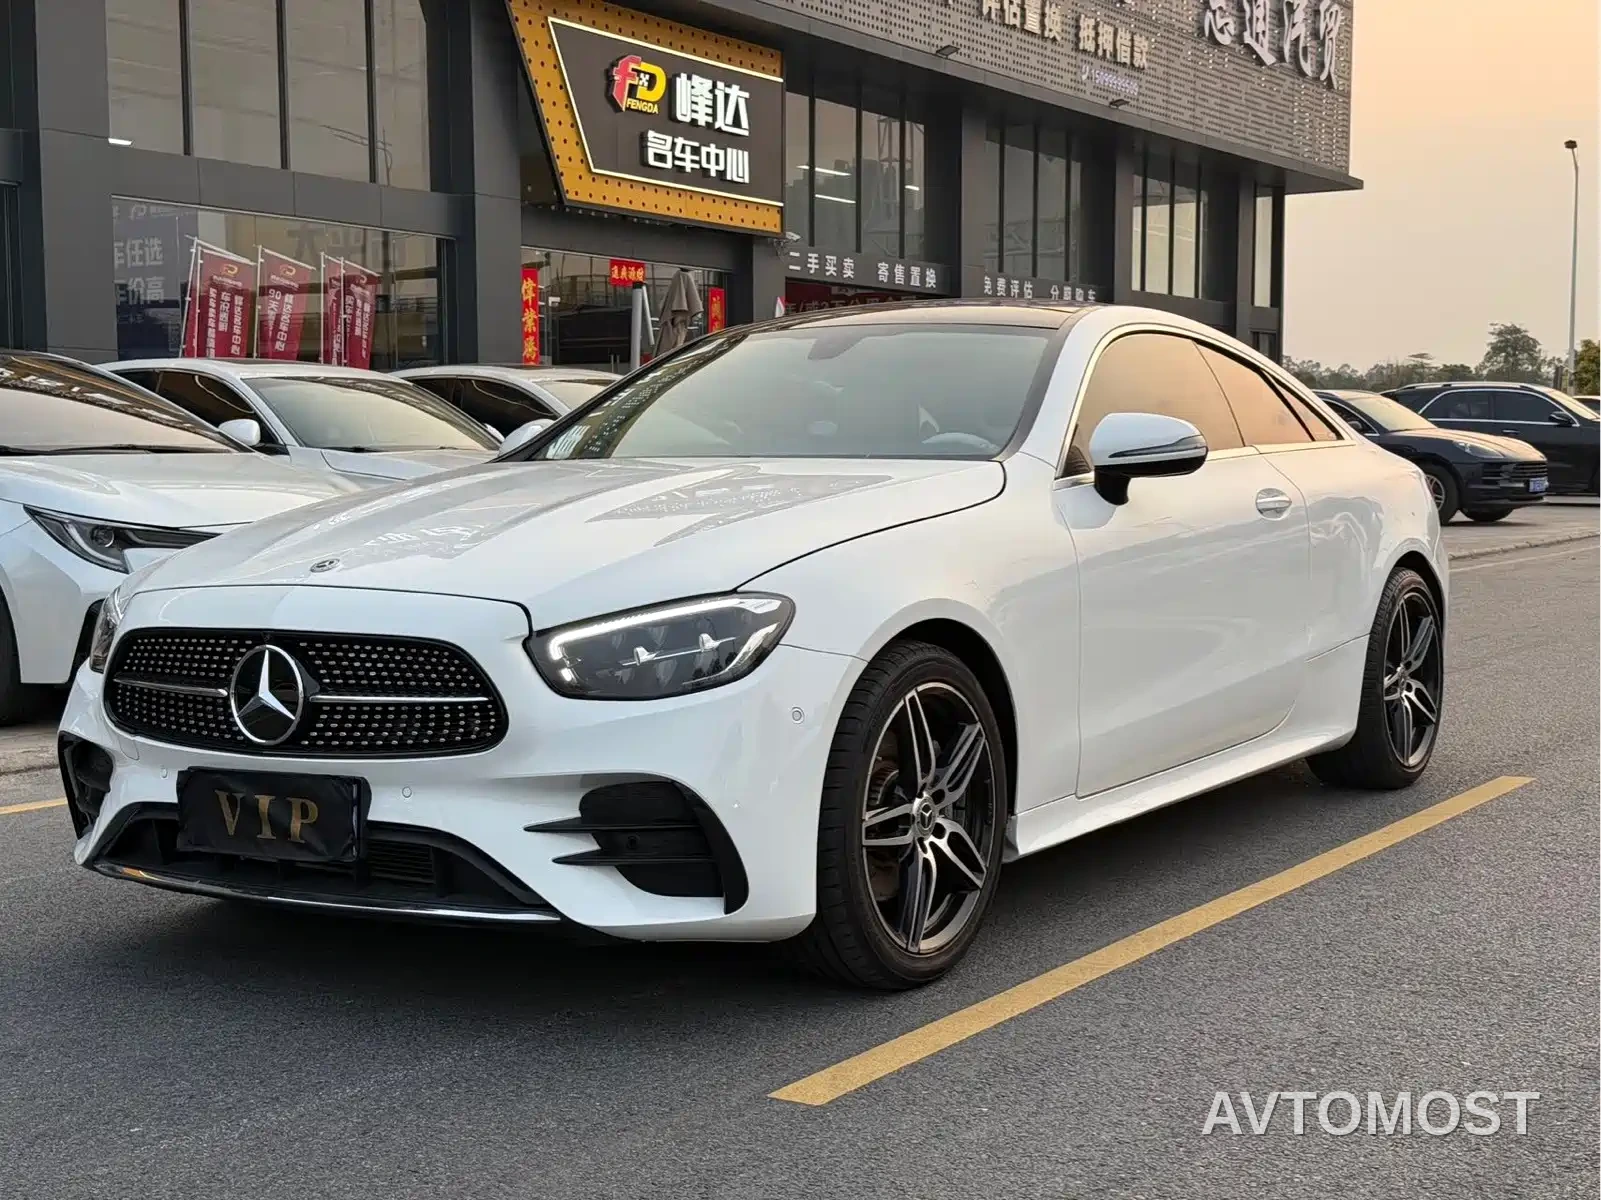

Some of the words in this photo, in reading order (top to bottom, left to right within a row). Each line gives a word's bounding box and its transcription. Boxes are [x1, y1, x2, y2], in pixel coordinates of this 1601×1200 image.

[626, 99, 660, 115] FENGDA
[675, 72, 750, 136] 峰达
[647, 130, 749, 184] 名车中心
[788, 251, 855, 279] 二手买卖
[877, 261, 936, 288] 寄售置换
[984, 275, 1033, 299] 免费评估
[1050, 284, 1096, 303] 分期购车
[214, 788, 320, 845] VIP
